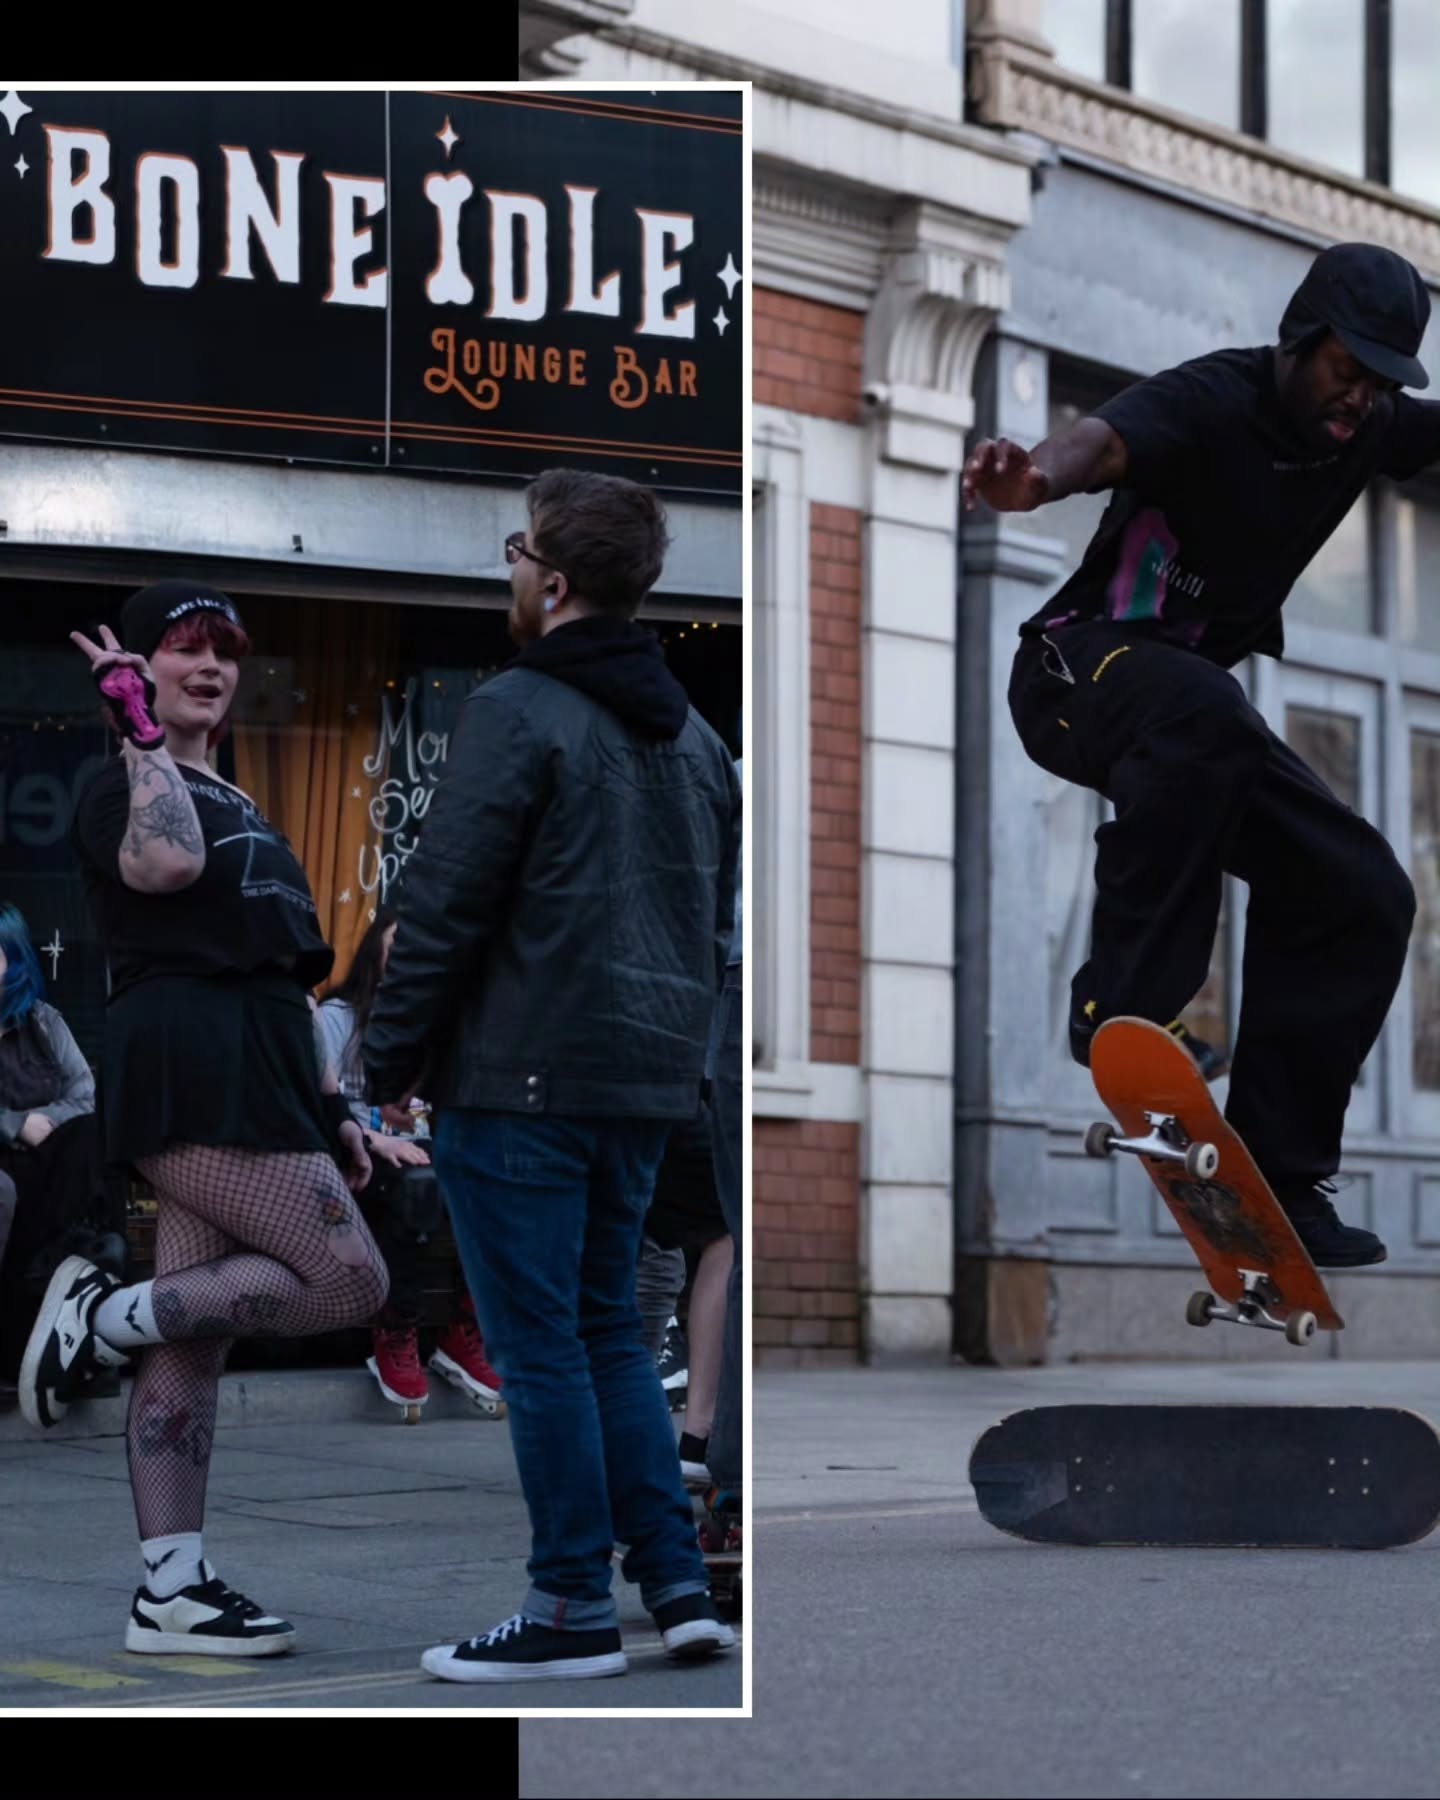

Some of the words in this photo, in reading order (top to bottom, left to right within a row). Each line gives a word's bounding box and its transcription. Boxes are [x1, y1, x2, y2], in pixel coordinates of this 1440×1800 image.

[41, 123, 388, 308] BONE
[423, 170, 697, 340] IDLE
[423, 327, 588, 411] LOUNGE
[609, 345, 698, 409] BAR
